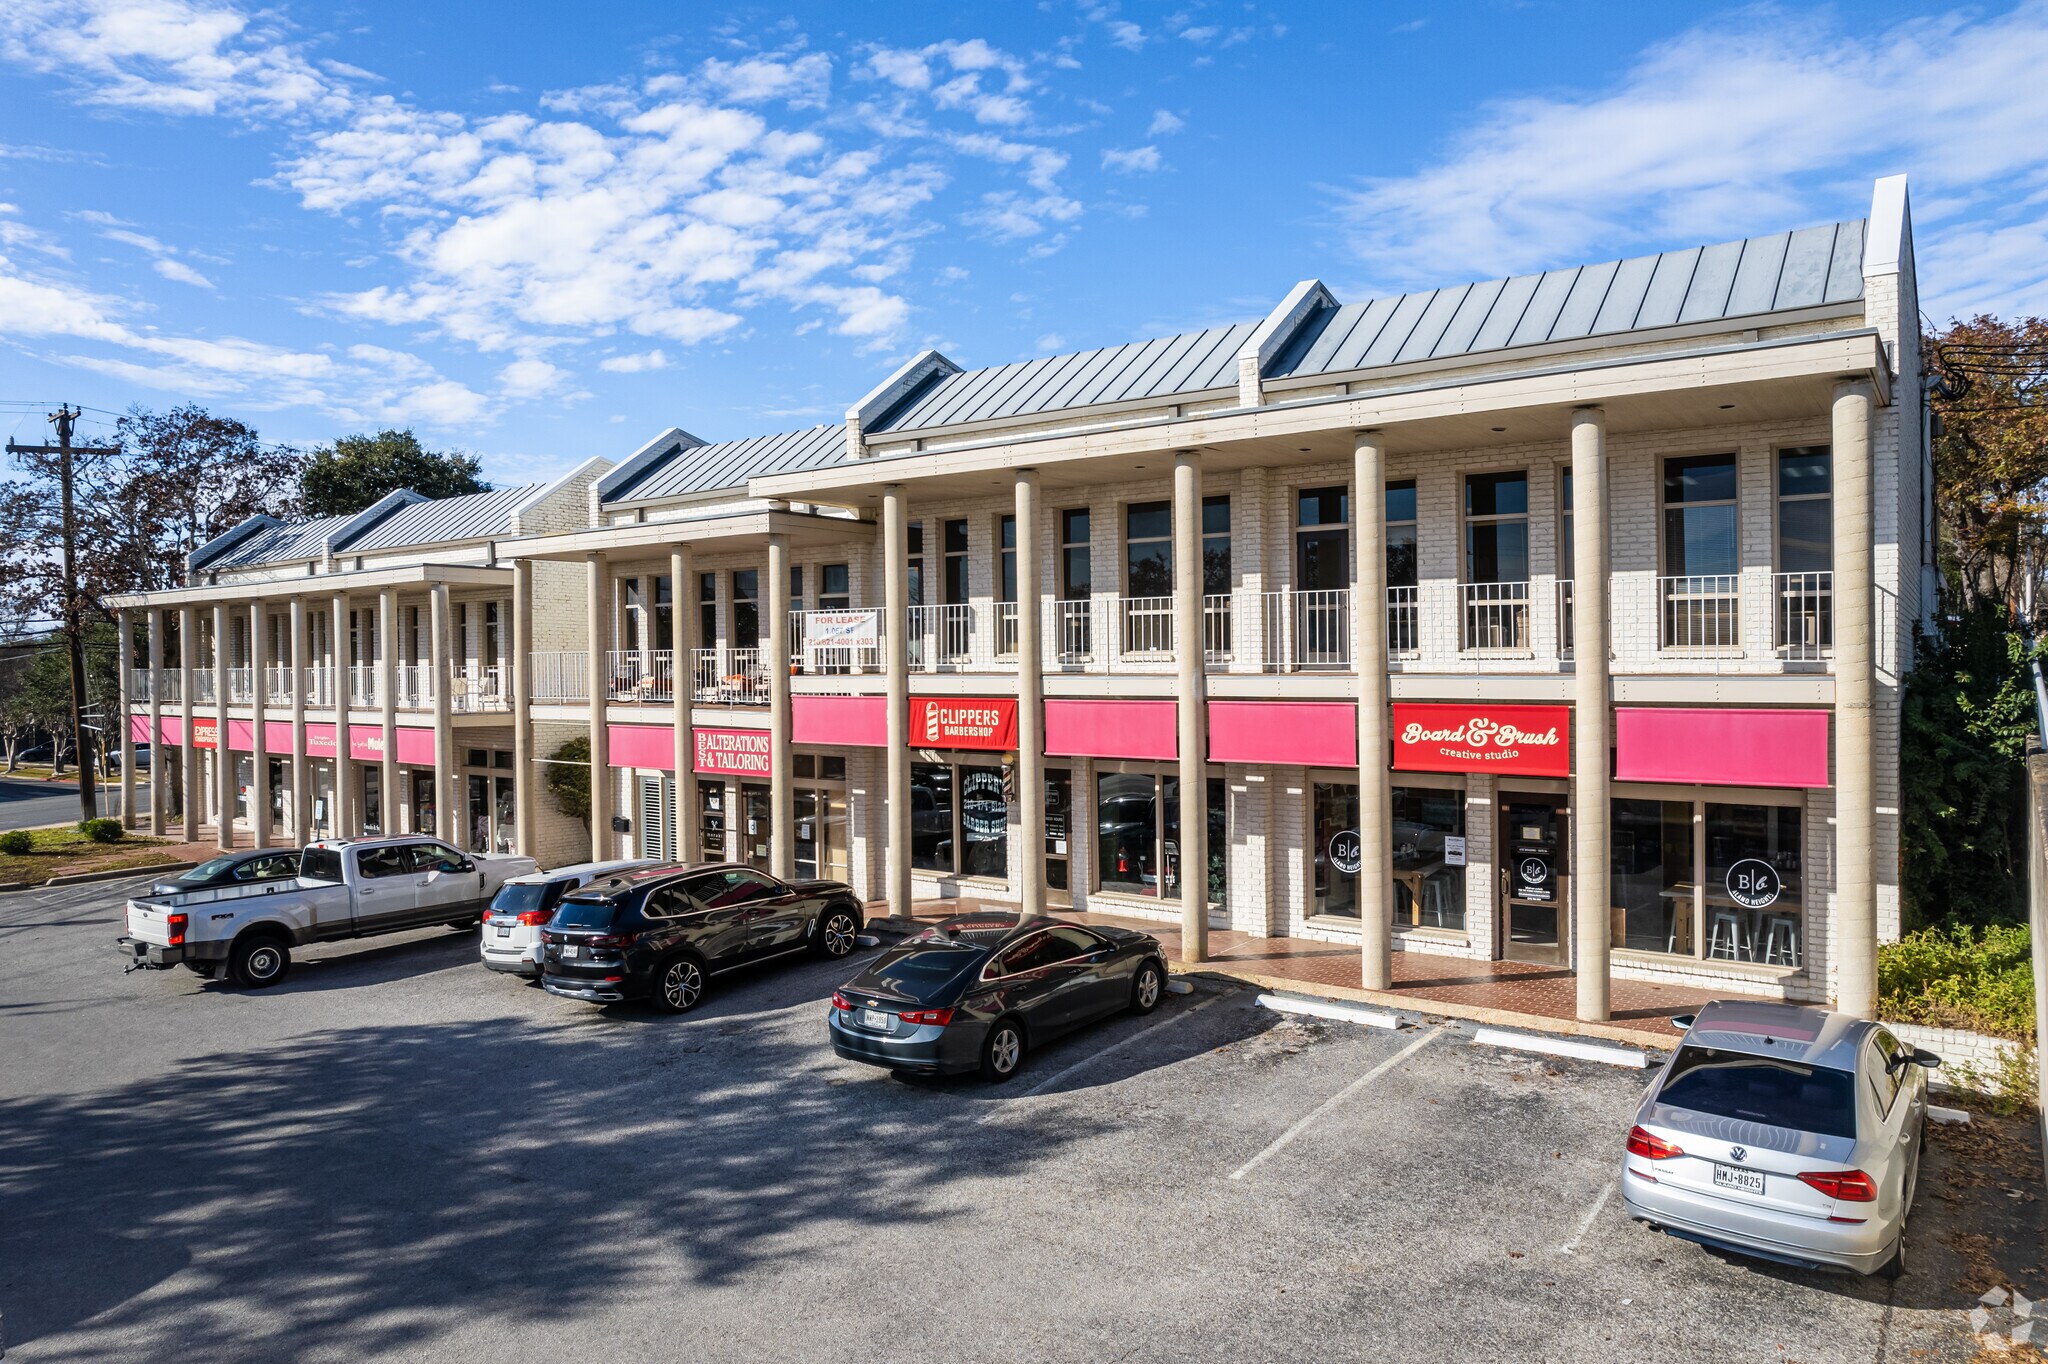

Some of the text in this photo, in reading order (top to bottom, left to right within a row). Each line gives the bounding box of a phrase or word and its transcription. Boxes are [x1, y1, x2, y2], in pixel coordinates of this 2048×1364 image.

[815, 615, 866, 624] FOR LEASE
[845, 626, 855, 634] SF
[856, 637, 874, 646] x303
[940, 708, 999, 726] CLIPPERS
[194, 725, 218, 737] EXPRESS
[944, 725, 993, 737] BARBERSHOP
[1401, 717, 1560, 747] Board & Brush
[706, 733, 769, 753] ALTERATIONS
[1439, 747, 1519, 760] creative studio
[706, 751, 769, 772] & TAILORING
[963, 812, 990, 834] BARBER
[1346, 861, 1362, 871] HEIGHT
[1731, 889, 1775, 906] ALAMO HEIGHTS
